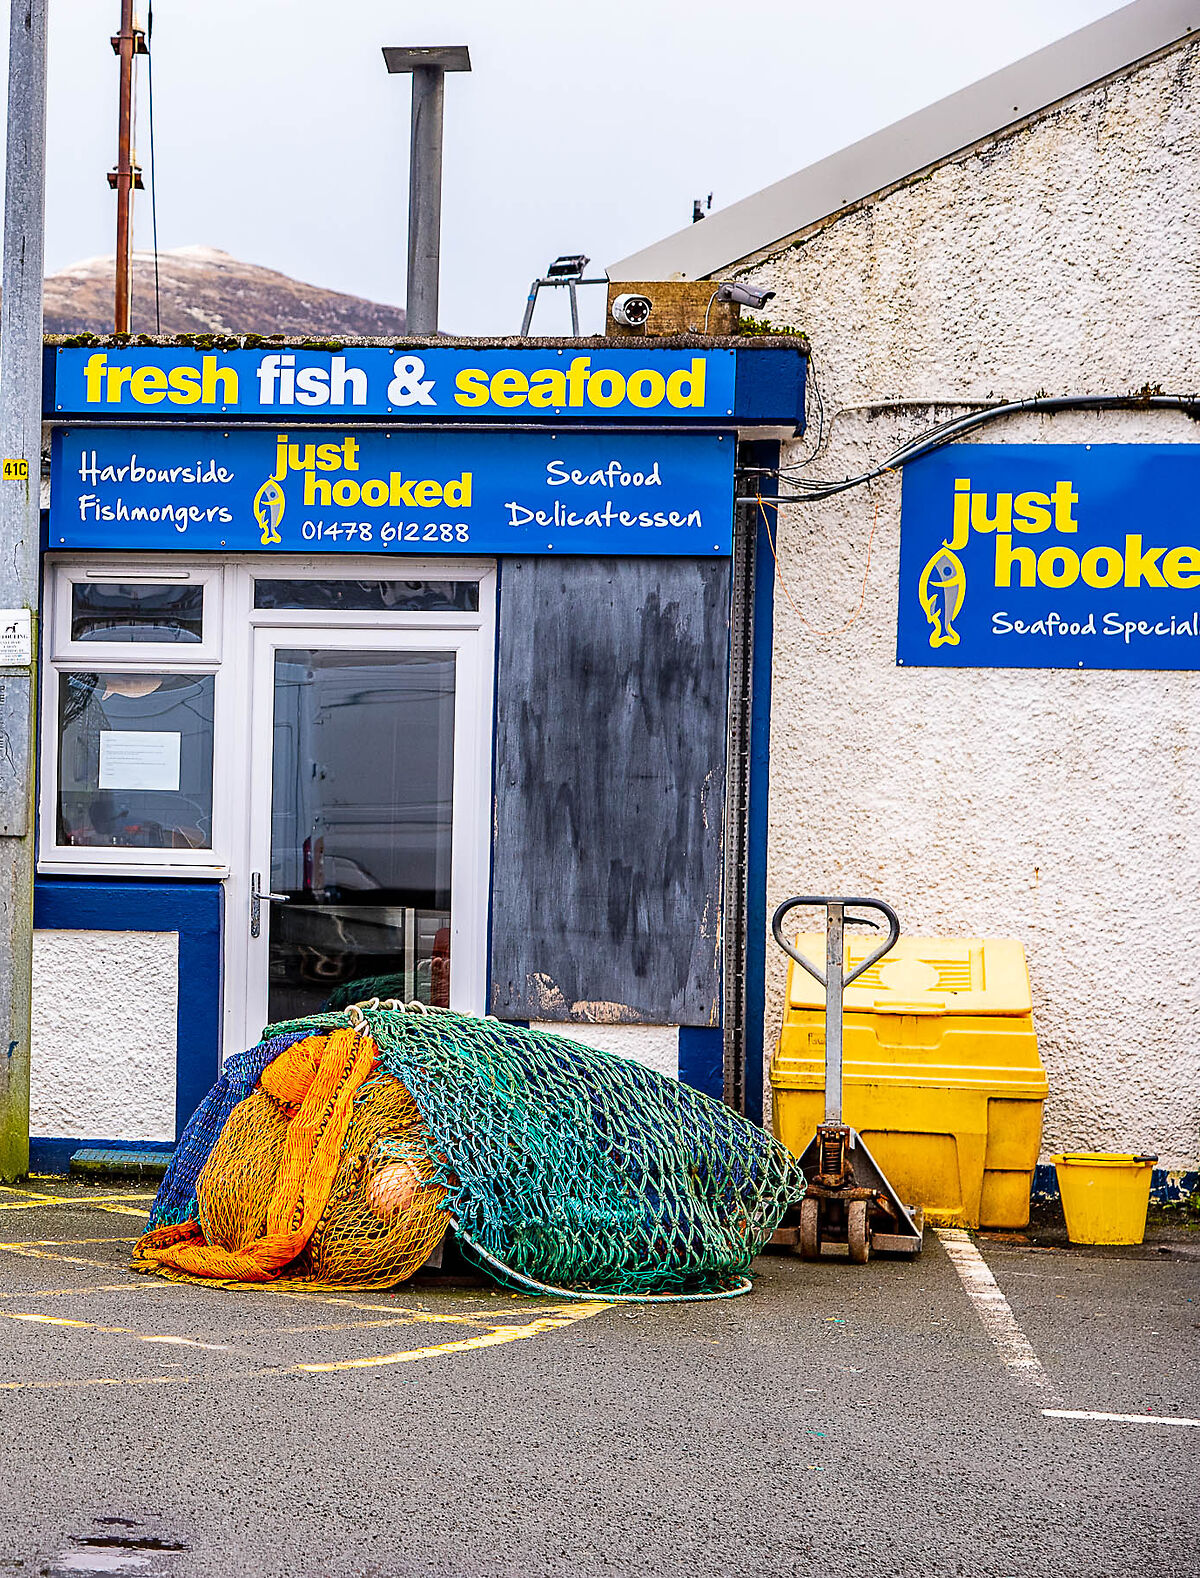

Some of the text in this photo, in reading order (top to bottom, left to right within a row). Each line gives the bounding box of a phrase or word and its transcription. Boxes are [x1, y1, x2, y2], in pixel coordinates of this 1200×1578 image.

[83, 353, 706, 409] fresh fish & seafood
[4, 462, 27, 476] 41C
[78, 450, 235, 487] Harbourside
[274, 435, 360, 482] just
[546, 460, 662, 488] Seafood
[304, 468, 473, 508] hooked
[78, 494, 233, 533] Fishmongers
[301, 521, 470, 543] 01478 612288
[505, 500, 703, 528] Delicatessen
[942, 478, 1079, 550] just
[991, 612, 1200, 644] Seafood Special
